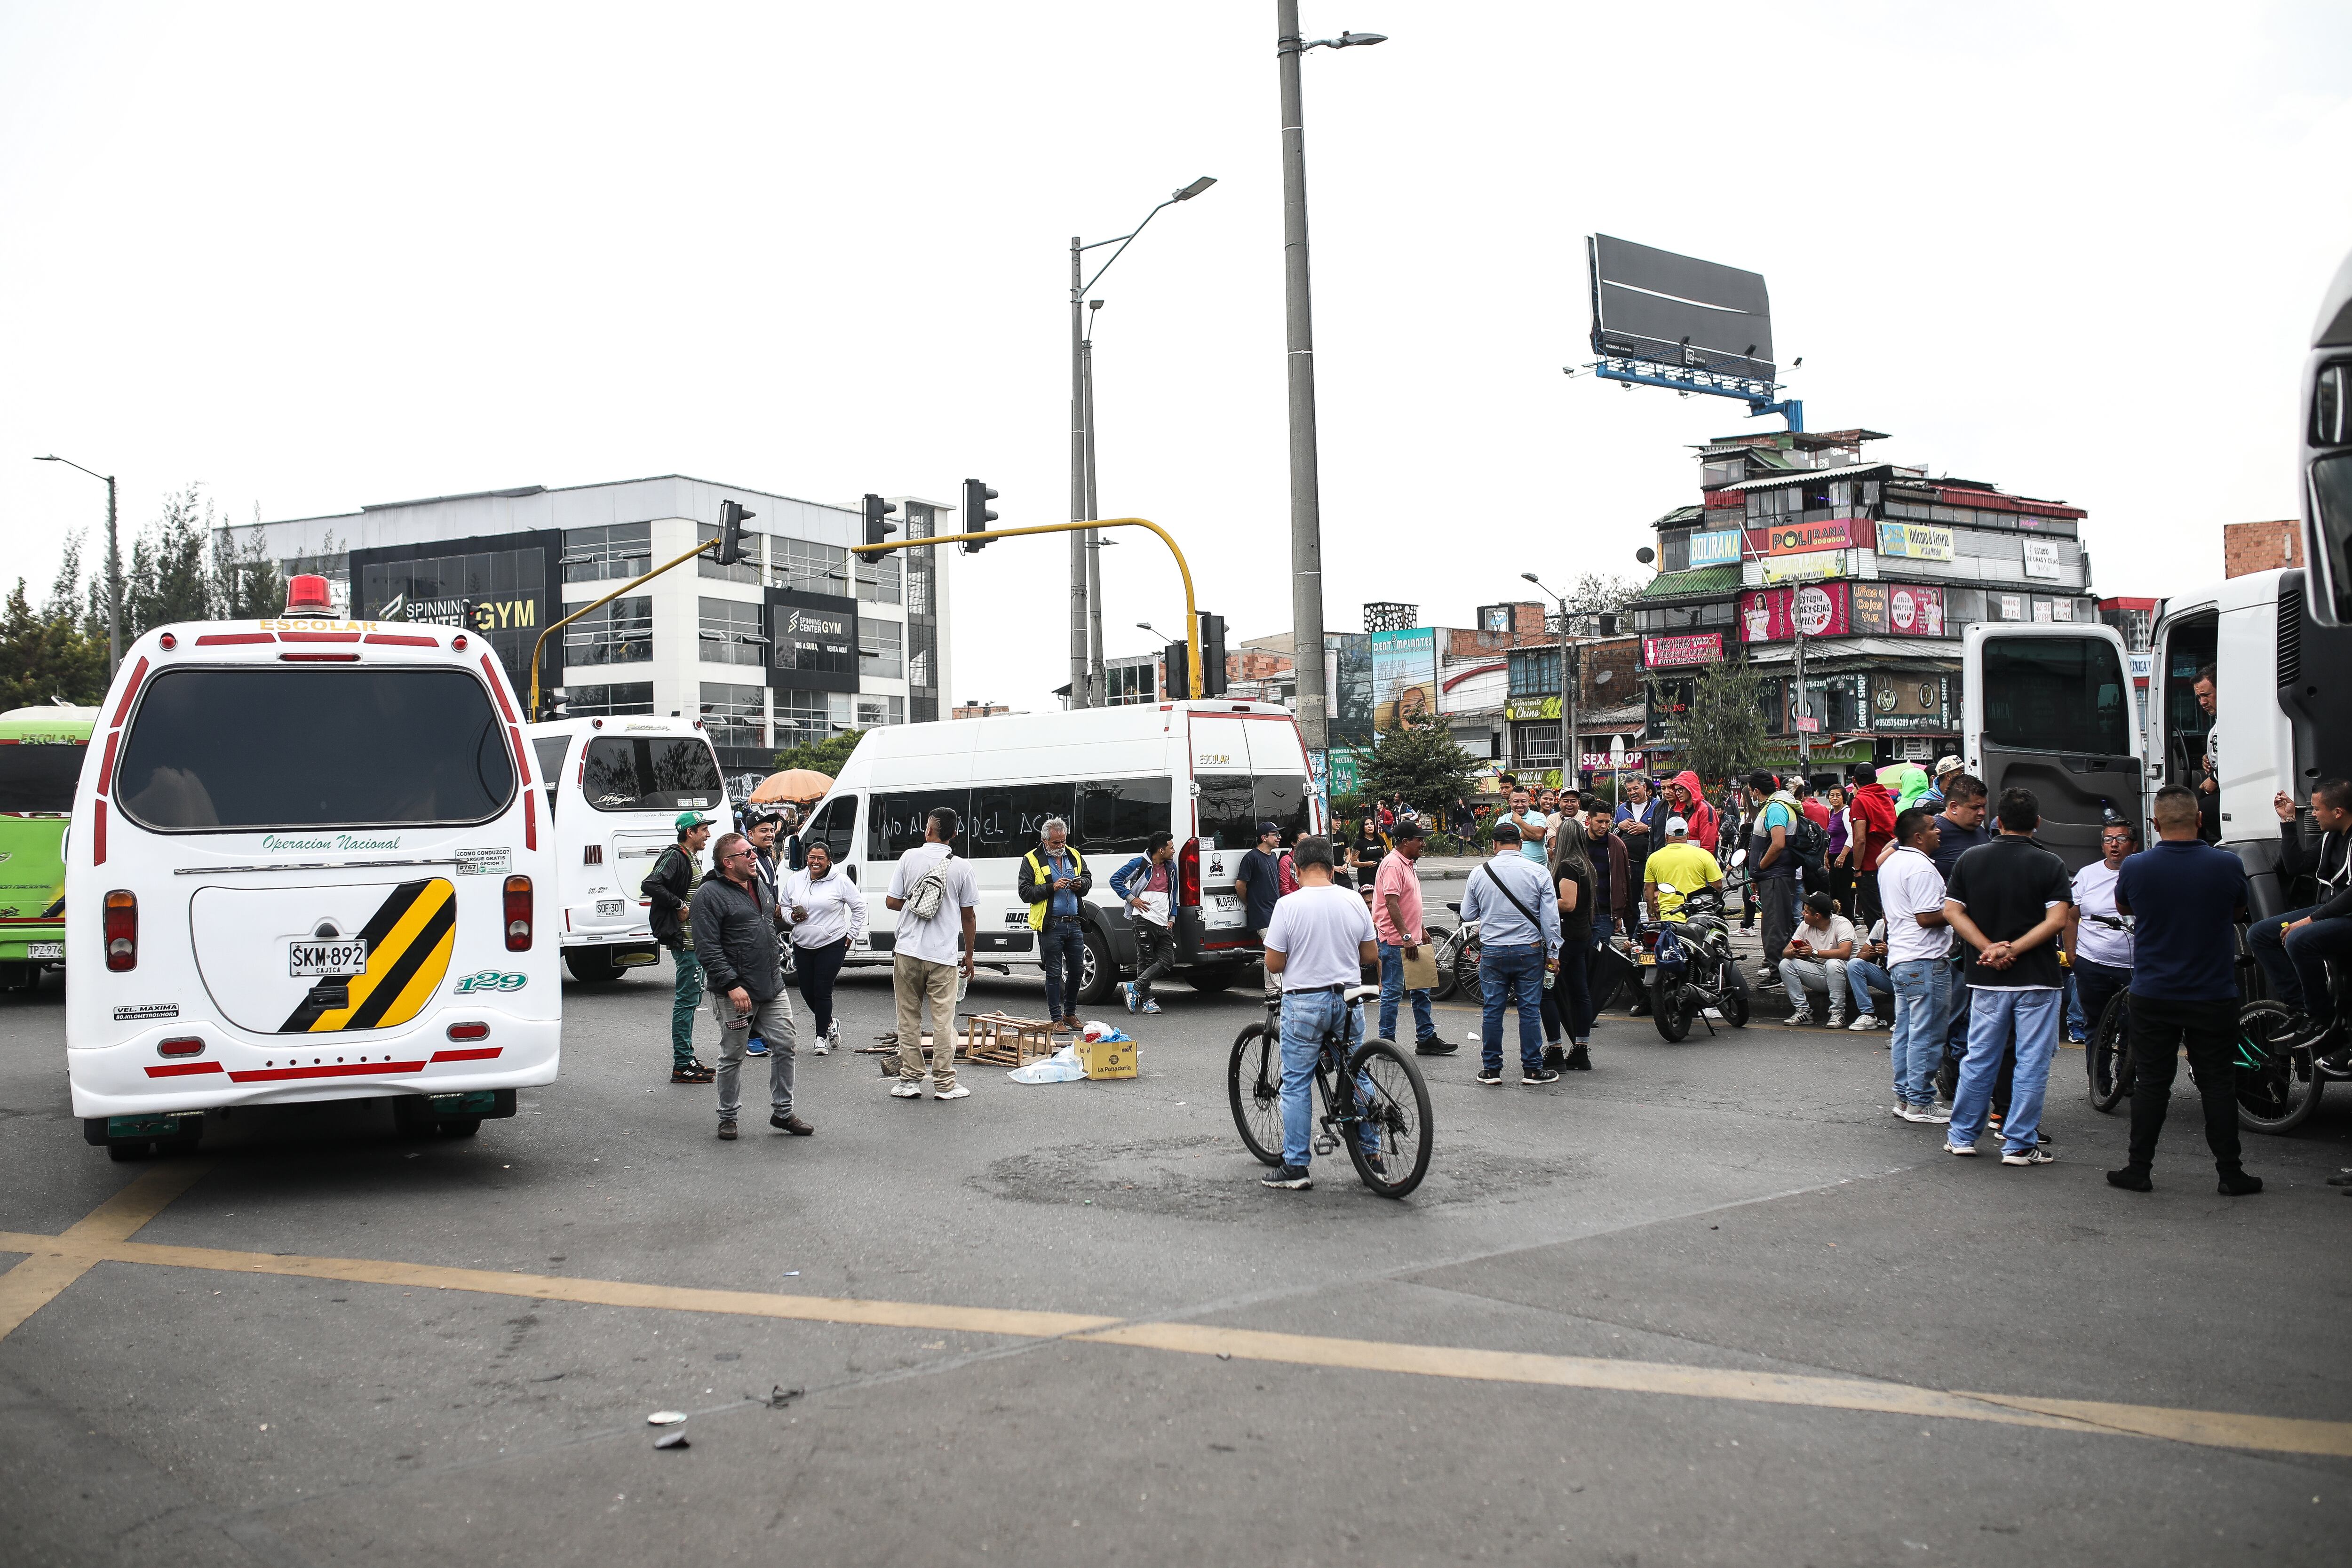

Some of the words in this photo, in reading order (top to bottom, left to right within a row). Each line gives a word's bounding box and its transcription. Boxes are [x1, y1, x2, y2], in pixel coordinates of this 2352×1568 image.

[1909, 528, 1928, 544] Bolirana
[1929, 532, 1932, 545] &
[1933, 531, 1949, 546] Cerveza
[1692, 534, 1739, 561] BOLIRANA
[1804, 570, 1825, 579] MIRADOR
[1853, 585, 1877, 598] Uñas
[1799, 595, 1822, 604] ESTUDIO
[1857, 598, 1883, 612] Cejas
[2054, 599, 2071, 608] ARRIENDO
[477, 599, 534, 630] GYM
[1792, 605, 1807, 614] UAS
[1813, 604, 1830, 613] CEJAS
[1862, 612, 1879, 623] Yus
[260, 620, 378, 631] ESCOLAR
[800, 617, 821, 626] SPINNING
[822, 621, 841, 634] GYM
[800, 624, 821, 634] CENTER
[806, 642, 818, 652] SUBA,
[1657, 638, 1670, 651] UÑAS
[1670, 639, 1675, 649] Y
[1675, 637, 1691, 649] CEJAS
[1657, 650, 1680, 659] CURSOS
[1858, 674, 1866, 699] SHOP
[1511, 699, 1542, 708] Restaurante
[1516, 707, 1541, 718] Chino
[1858, 700, 1867, 727] GROW
[21, 734, 75, 745] ESCOLAR
[1200, 754, 1230, 764] ESCOLAR
[1583, 753, 1605, 765] SEX
[1609, 752, 1642, 765] SOP
[1534, 771, 1544, 781] AN
[883, 817, 901, 840] NO
[910, 812, 965, 836] ALA
[972, 812, 1003, 837] DEL
[262, 835, 332, 852] Operacion
[336, 835, 401, 850] Nacional
[454, 970, 527, 994] 129
